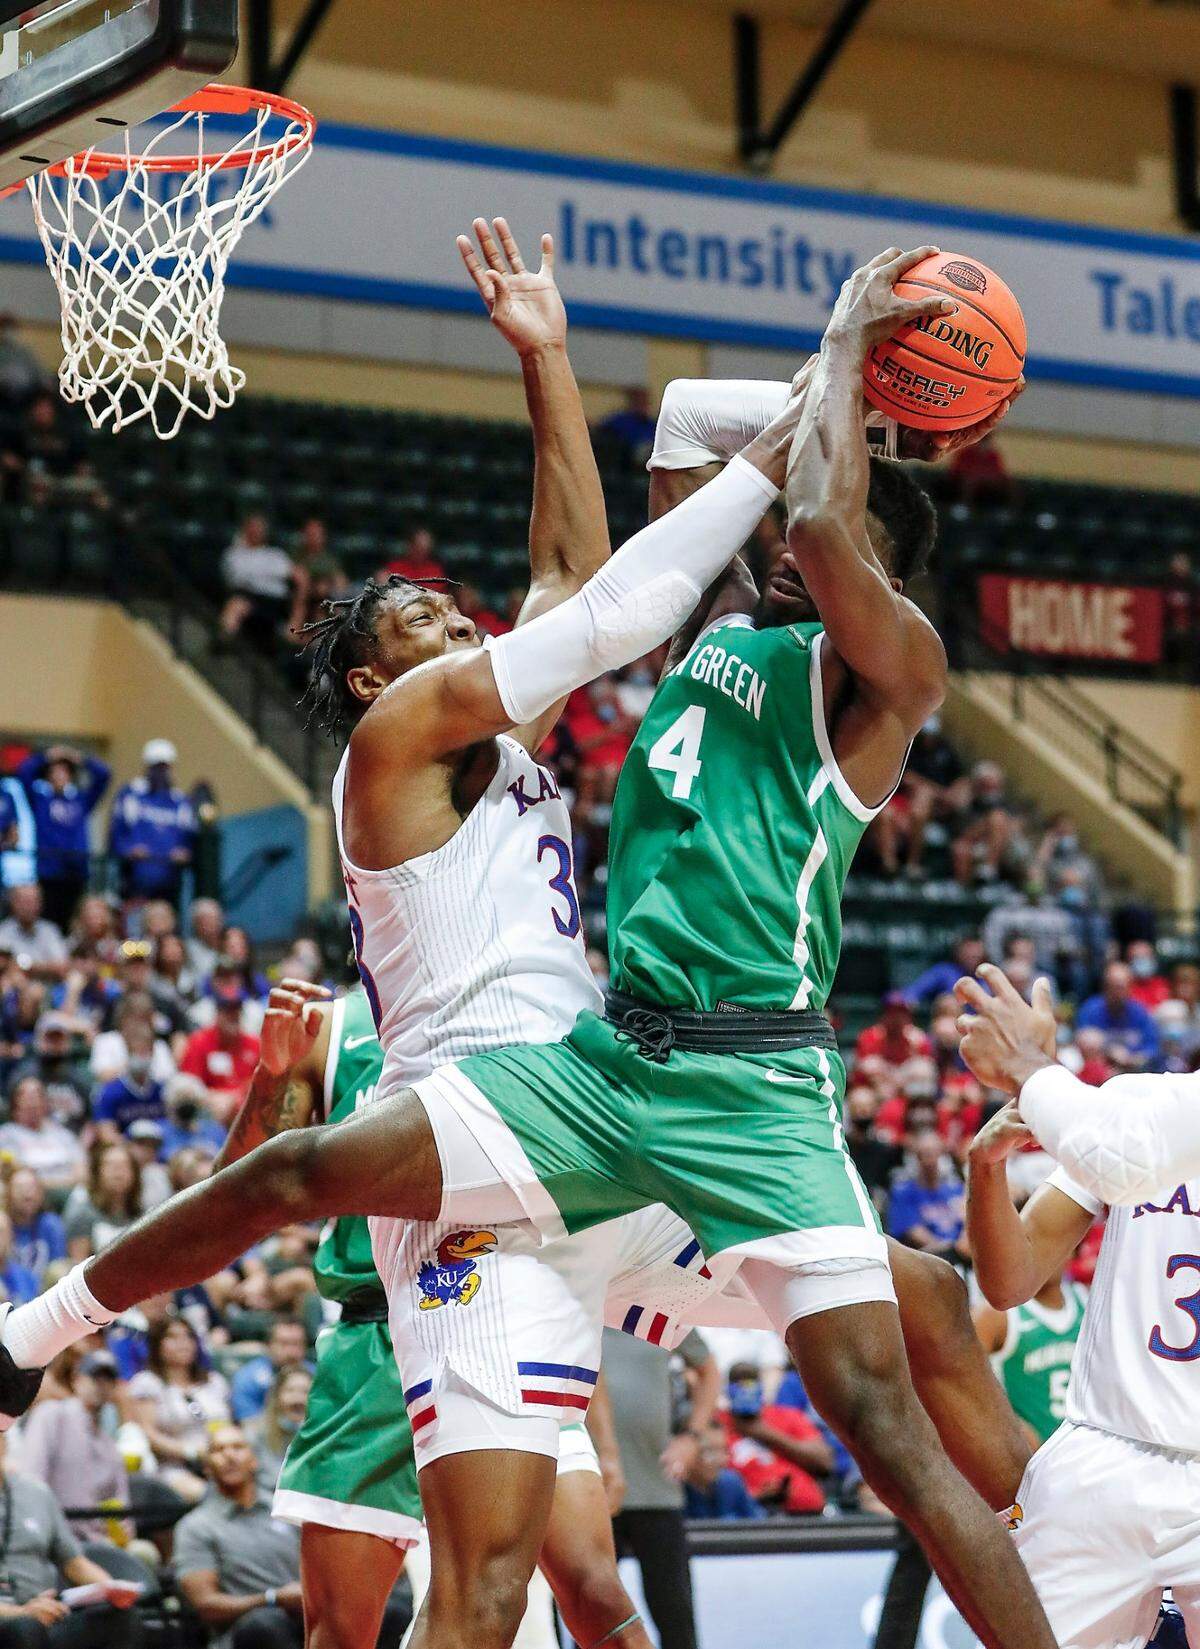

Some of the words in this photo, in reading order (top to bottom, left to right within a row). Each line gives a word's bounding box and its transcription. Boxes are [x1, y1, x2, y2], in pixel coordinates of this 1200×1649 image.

[559, 199, 856, 310] Intensity
[871, 346, 967, 400] LEGACY
[914, 315, 994, 370] ALDING
[1008, 579, 1134, 658] HOME
[690, 644, 767, 721] GREEN
[648, 704, 707, 800] 4
[436, 1270, 458, 1287] KU
[1148, 1254, 1200, 1362] 3
